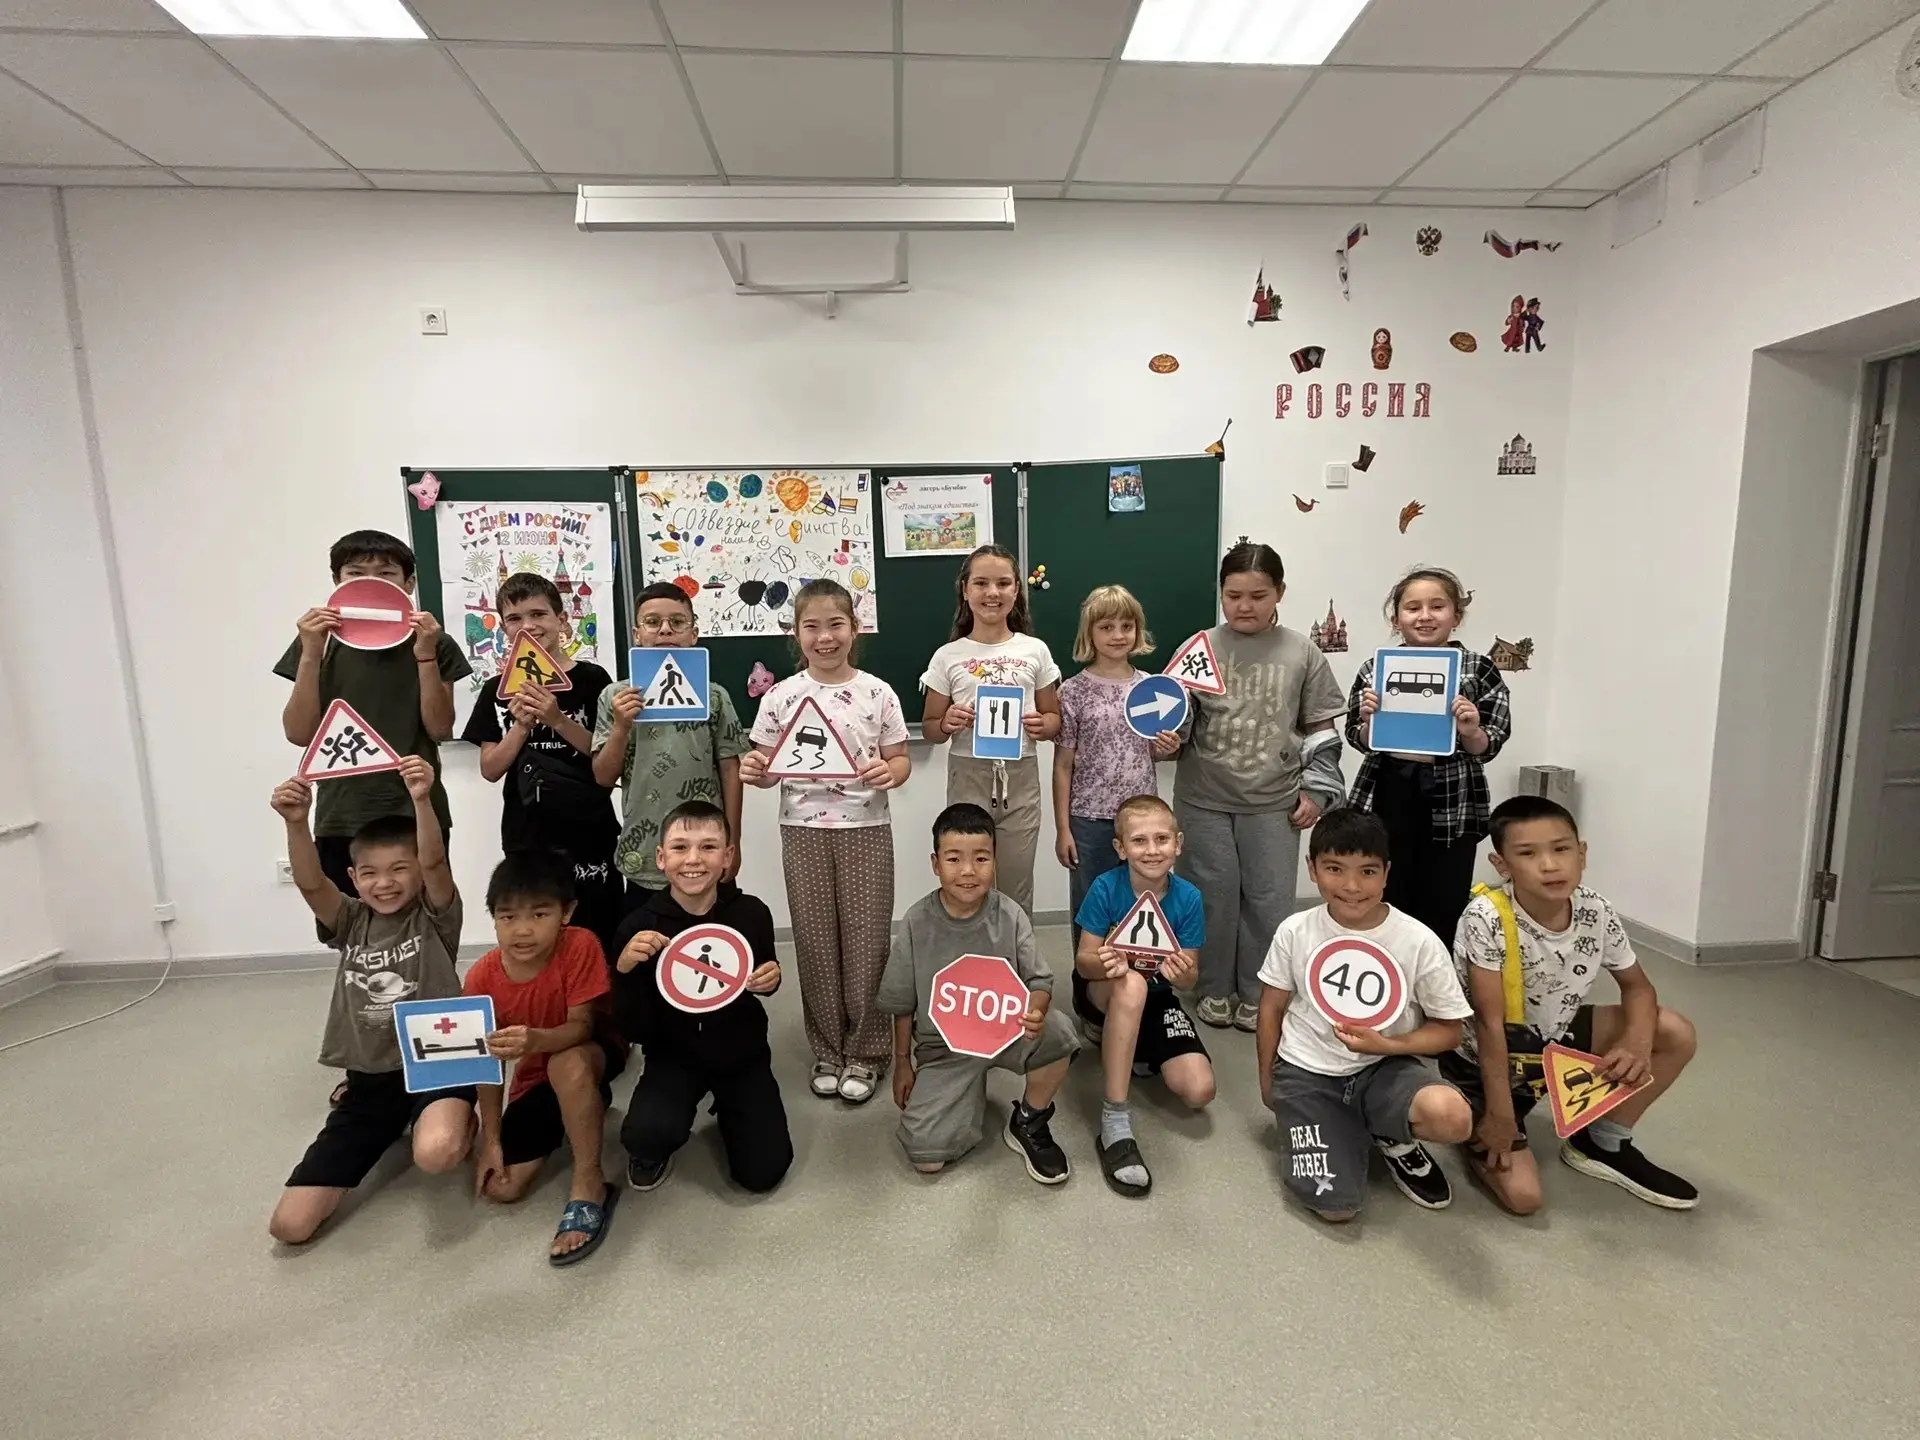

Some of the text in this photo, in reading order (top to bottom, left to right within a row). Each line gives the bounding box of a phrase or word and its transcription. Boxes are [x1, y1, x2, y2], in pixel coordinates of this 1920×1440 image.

[1275, 382, 1432, 419] РОССИЯ
[464, 510, 588, 536] С ДНЁМ РОССИИ!
[494, 530, 558, 546] 12 ИЮНЯ
[1322, 962, 1386, 1007] 40
[936, 981, 1022, 1025] STOP
[1290, 1124, 1329, 1150] REAL
[1292, 1152, 1337, 1179] REBEL
